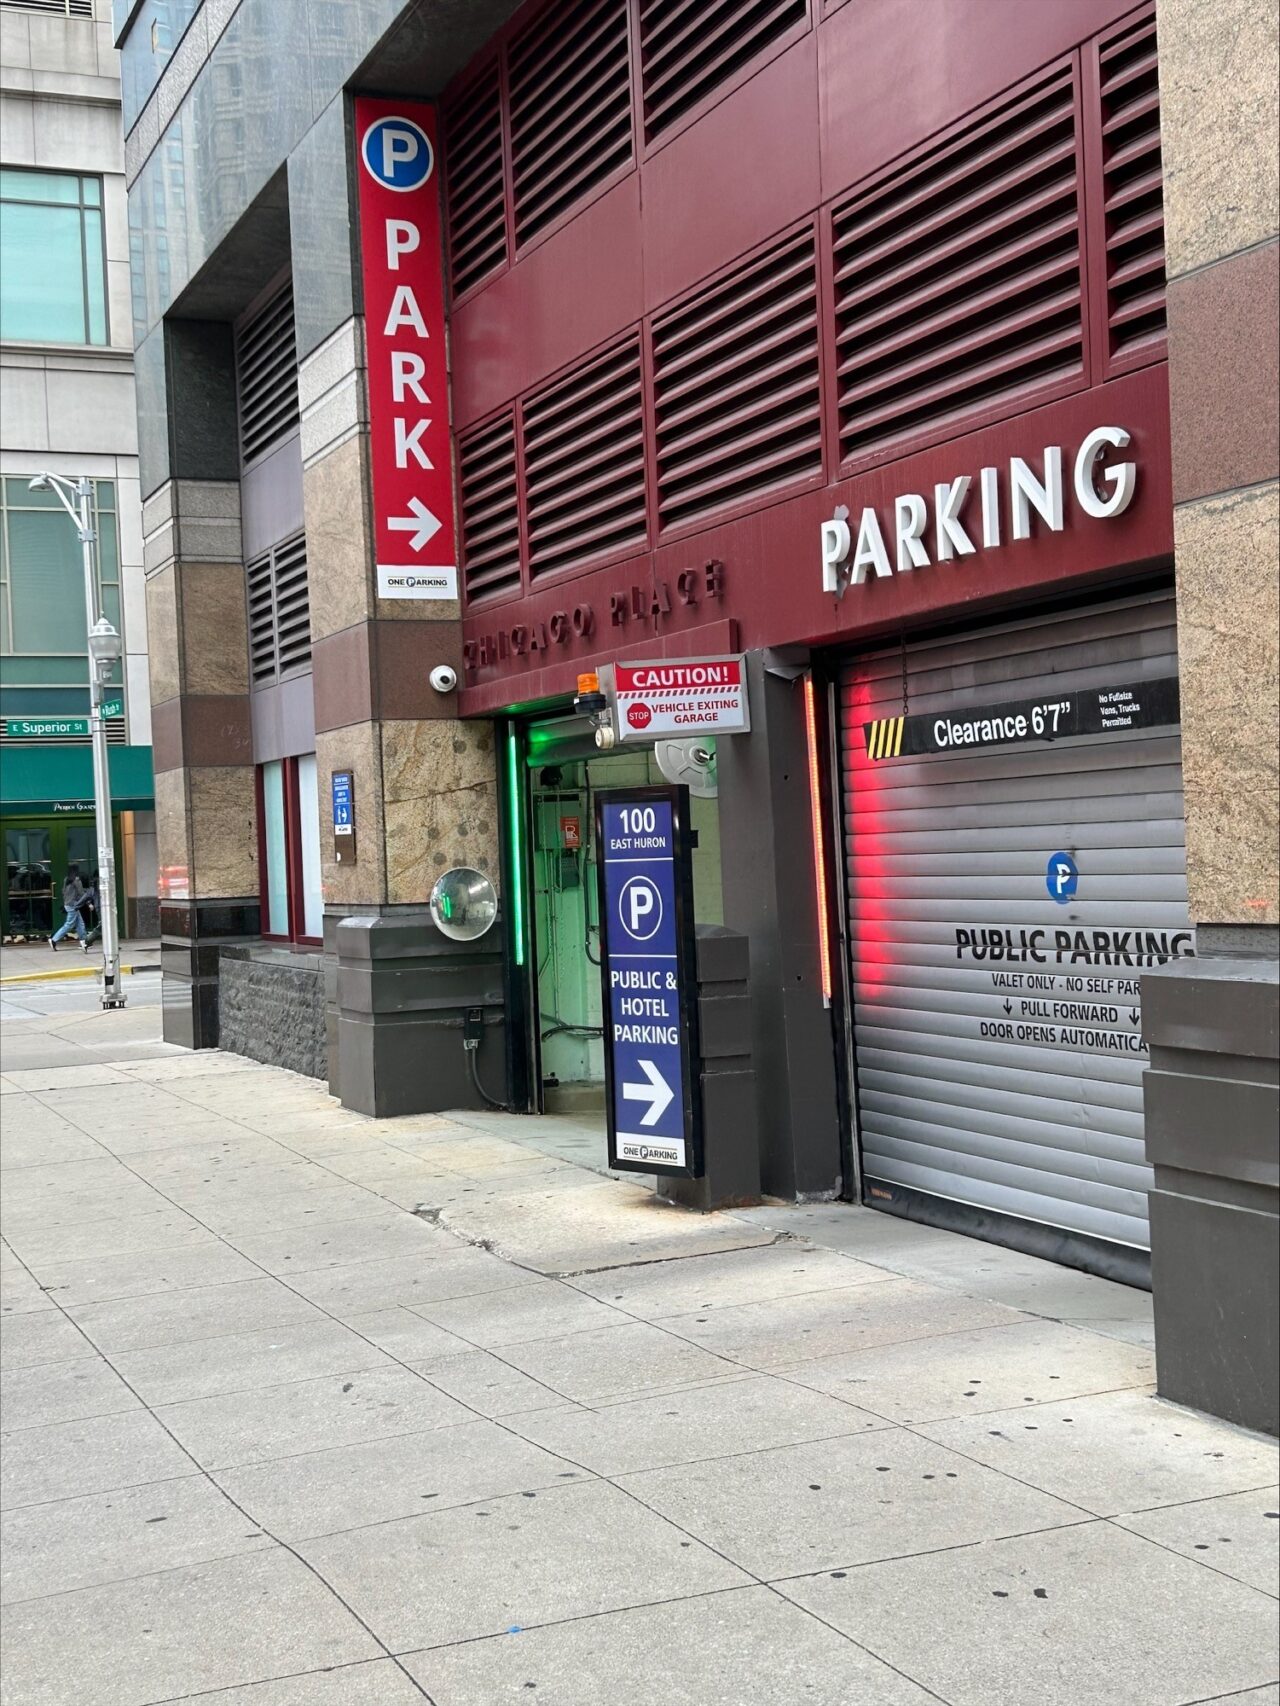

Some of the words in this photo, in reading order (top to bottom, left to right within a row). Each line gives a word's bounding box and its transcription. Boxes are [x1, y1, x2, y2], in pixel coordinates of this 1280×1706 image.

[383, 218, 435, 471] PARK
[821, 426, 1136, 592] PARKING
[463, 603, 595, 671] CHICAGO
[610, 559, 724, 627] PLACE
[632, 666, 729, 687] CAUTION!
[652, 702, 694, 713] VEHICLE
[697, 699, 739, 710] EXITING
[1098, 694, 1108, 704] No
[1118, 702, 1141, 713] Trucks
[629, 711, 649, 721] STOP
[674, 712, 719, 724] GARAGE
[12, 724, 19, 732] E
[22, 722, 72, 735] Superior
[74, 723, 83, 731] St
[933, 714, 1028, 747] Clearance
[620, 807, 656, 834] 100
[610, 838, 632, 850] EAST
[634, 836, 666, 849] HURON
[956, 928, 1047, 963] PUBLIC
[1055, 931, 1196, 968] PARKING
[611, 970, 662, 990] PUBLIC
[665, 971, 678, 990] &
[992, 972, 1024, 988] VALET
[1026, 975, 1056, 990] ONLY
[1066, 977, 1083, 992] NO
[1086, 978, 1114, 994] SELF
[621, 998, 669, 1017] HOTEL
[1021, 1001, 1050, 1018] PULL
[1053, 1003, 1119, 1023] FORWARD
[614, 1024, 679, 1046] PARKING
[980, 1022, 1014, 1039] DOOR
[1016, 1025, 1057, 1043] OPENS
[623, 1146, 639, 1156] ONE
